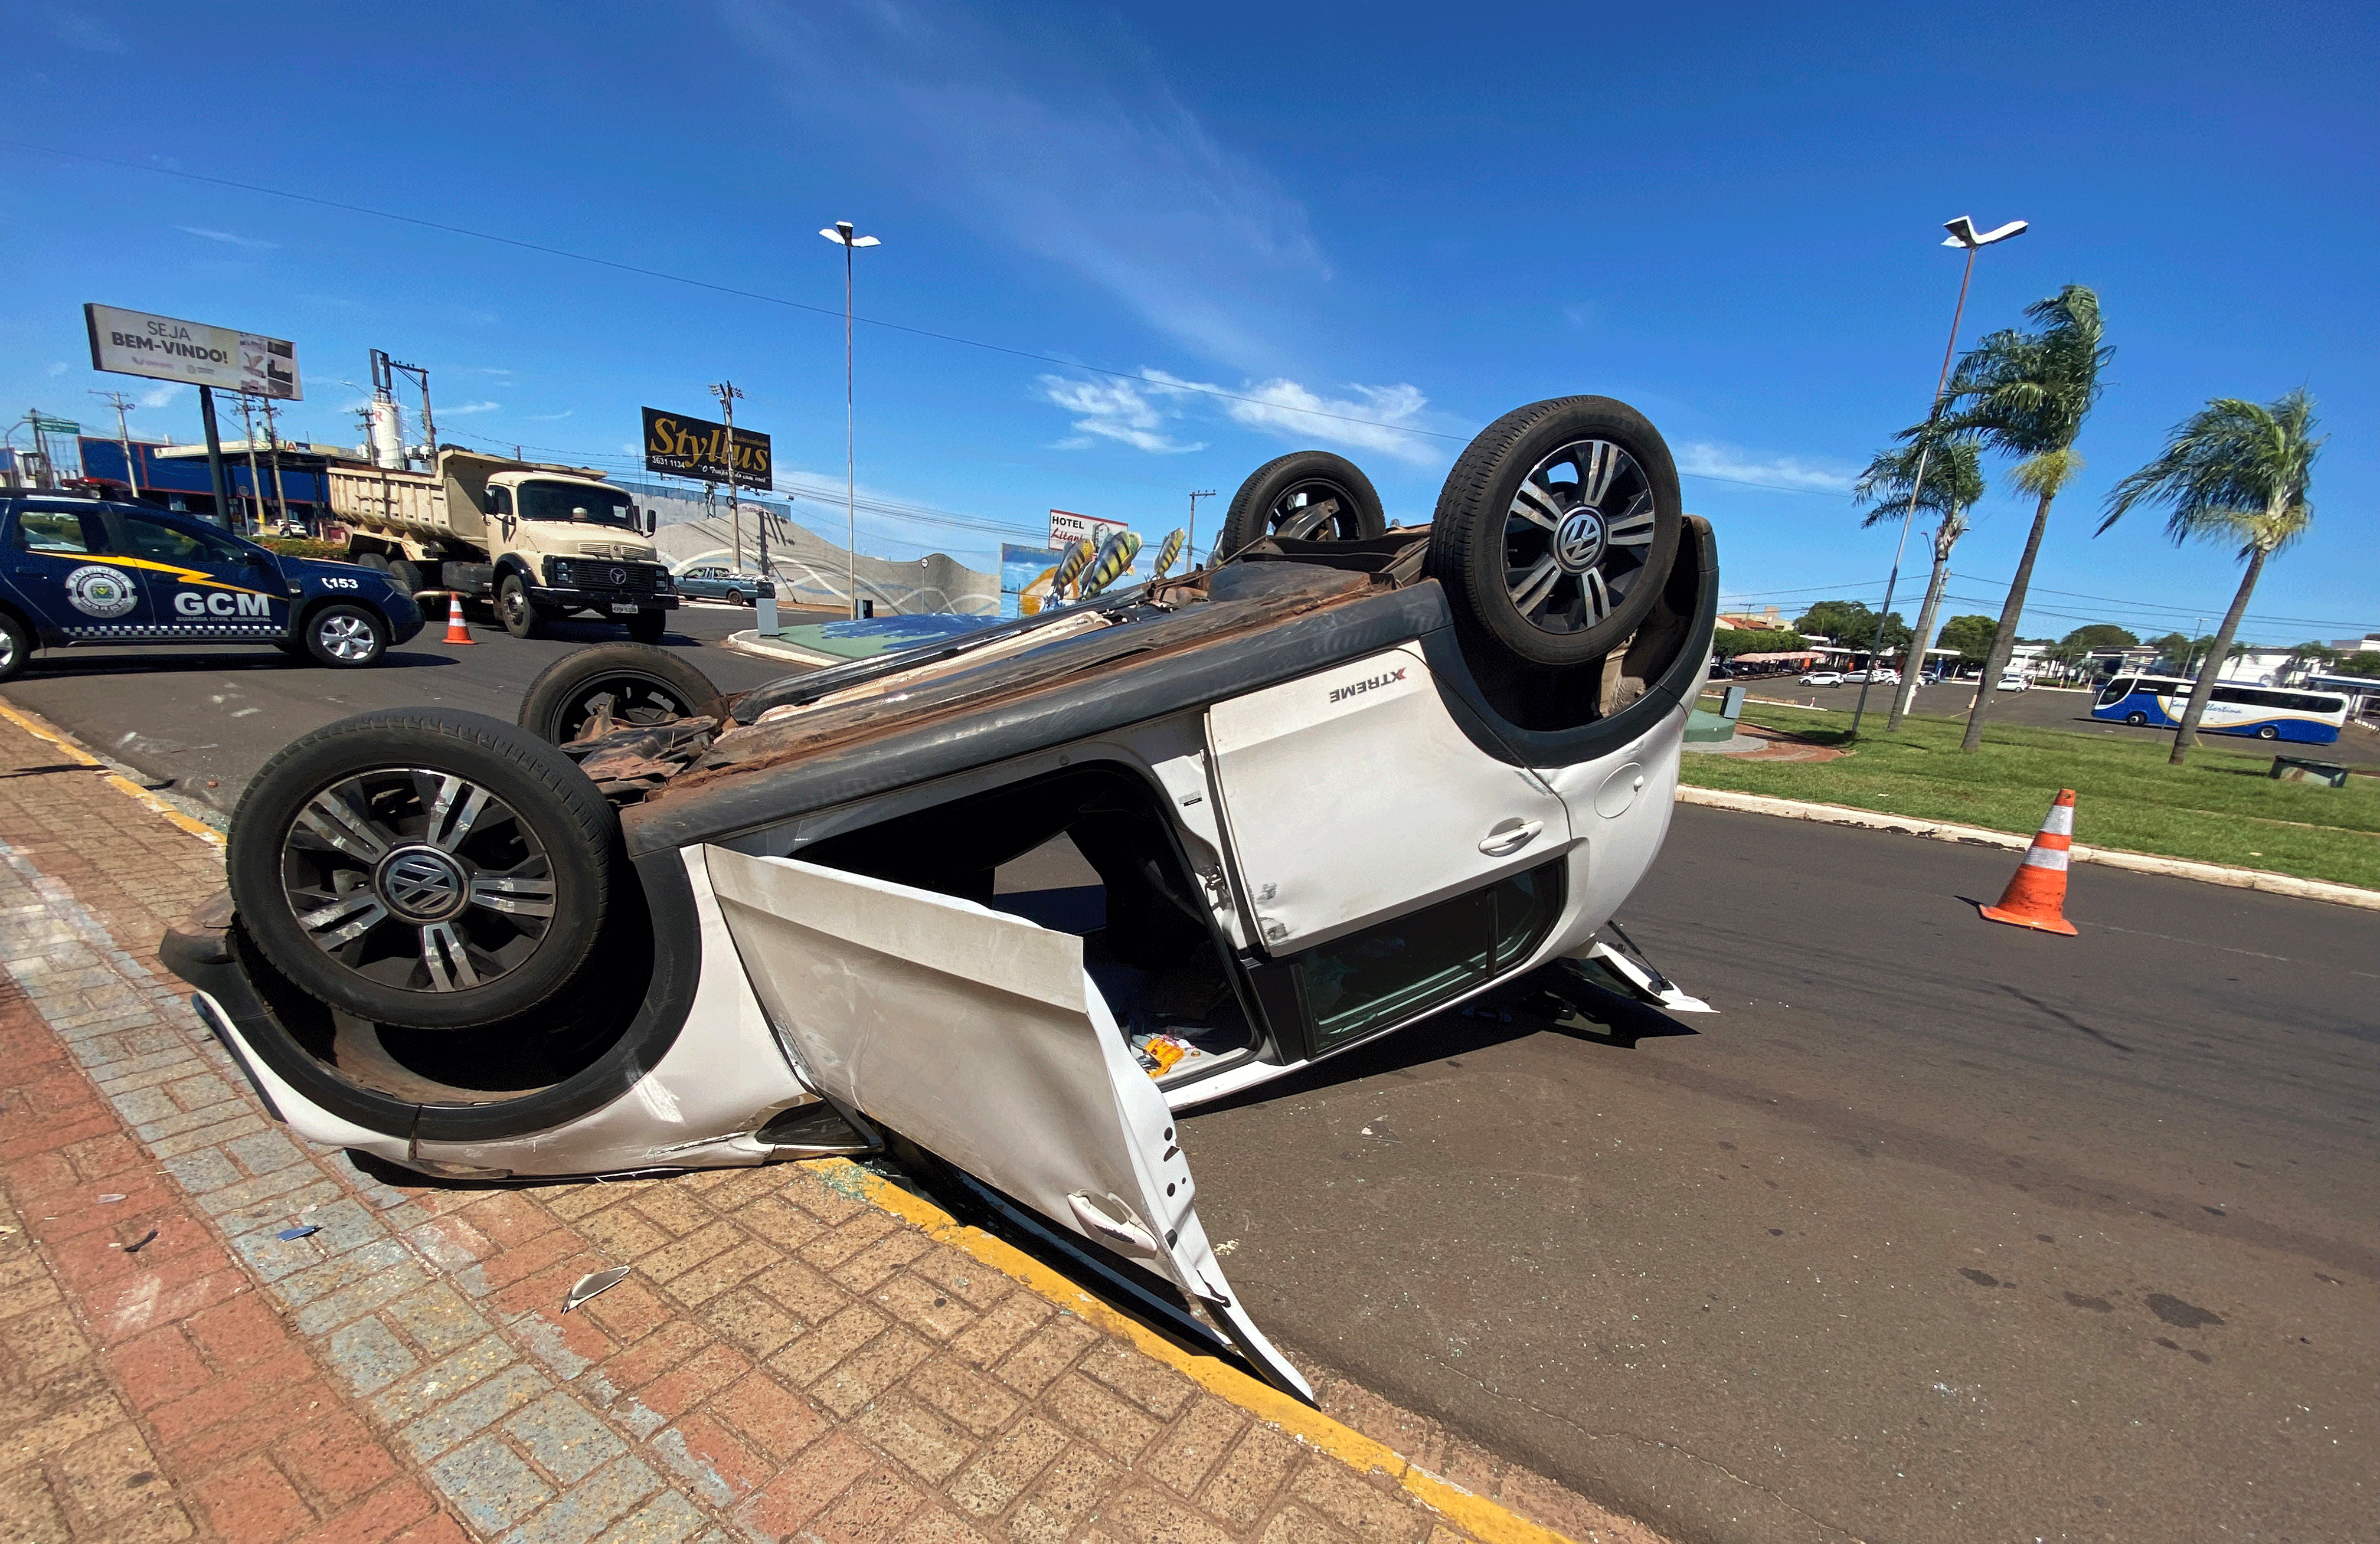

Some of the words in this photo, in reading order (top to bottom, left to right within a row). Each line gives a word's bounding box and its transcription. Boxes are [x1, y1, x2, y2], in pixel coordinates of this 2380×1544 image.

[147, 320, 191, 342] SEJA
[111, 331, 228, 364] BEM-VINDO!
[652, 456, 668, 466] 3631
[669, 459, 685, 469] 1134
[1052, 516, 1084, 529] HOTEL
[331, 578, 358, 589] 153
[174, 592, 271, 616] GCM
[1329, 666, 1407, 704] XTREME
[2206, 702, 2242, 714] lbertina
